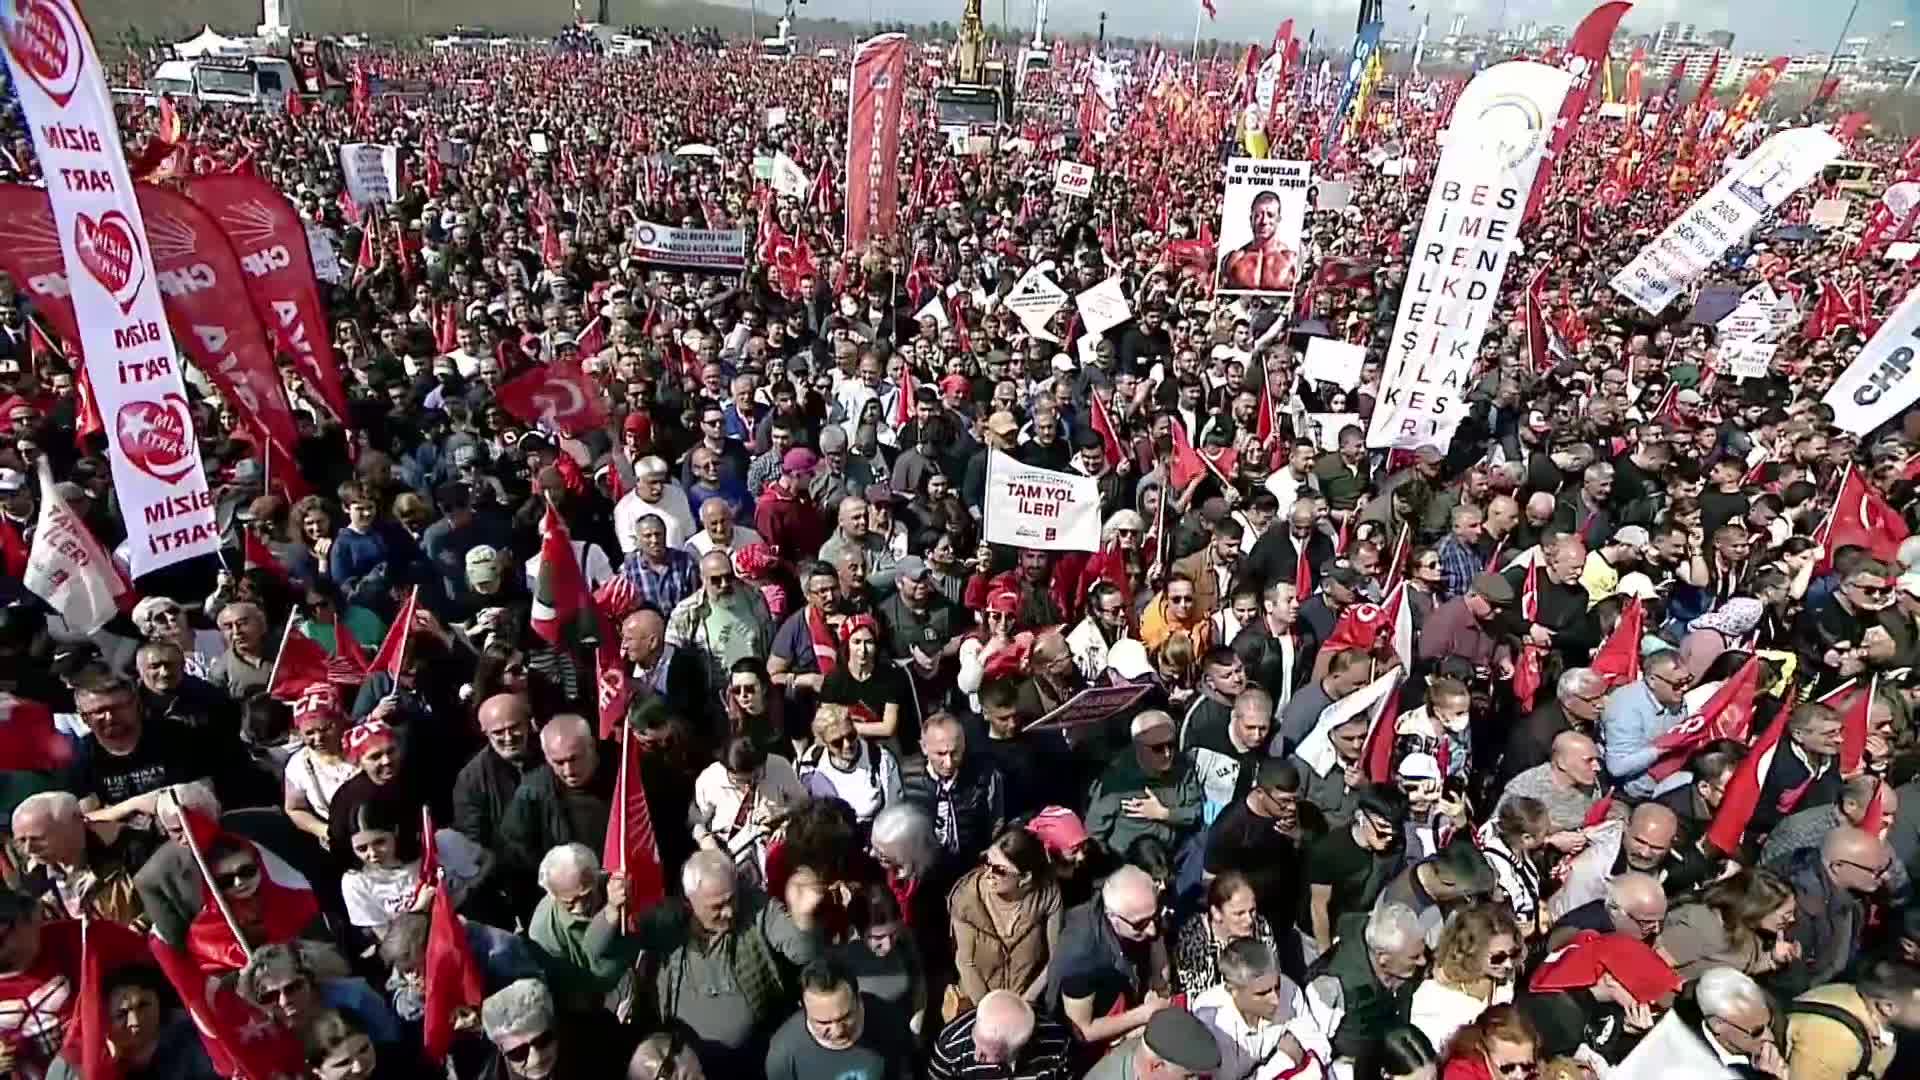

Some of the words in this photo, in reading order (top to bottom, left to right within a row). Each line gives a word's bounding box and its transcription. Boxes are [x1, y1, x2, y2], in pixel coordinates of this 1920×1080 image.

[1060, 174, 1088, 187] CHP
[1853, 346, 1915, 406] CHP
[1007, 482, 1041, 499] TAM
[1045, 486, 1077, 503] YOL
[1018, 497, 1061, 519] İLERİ
